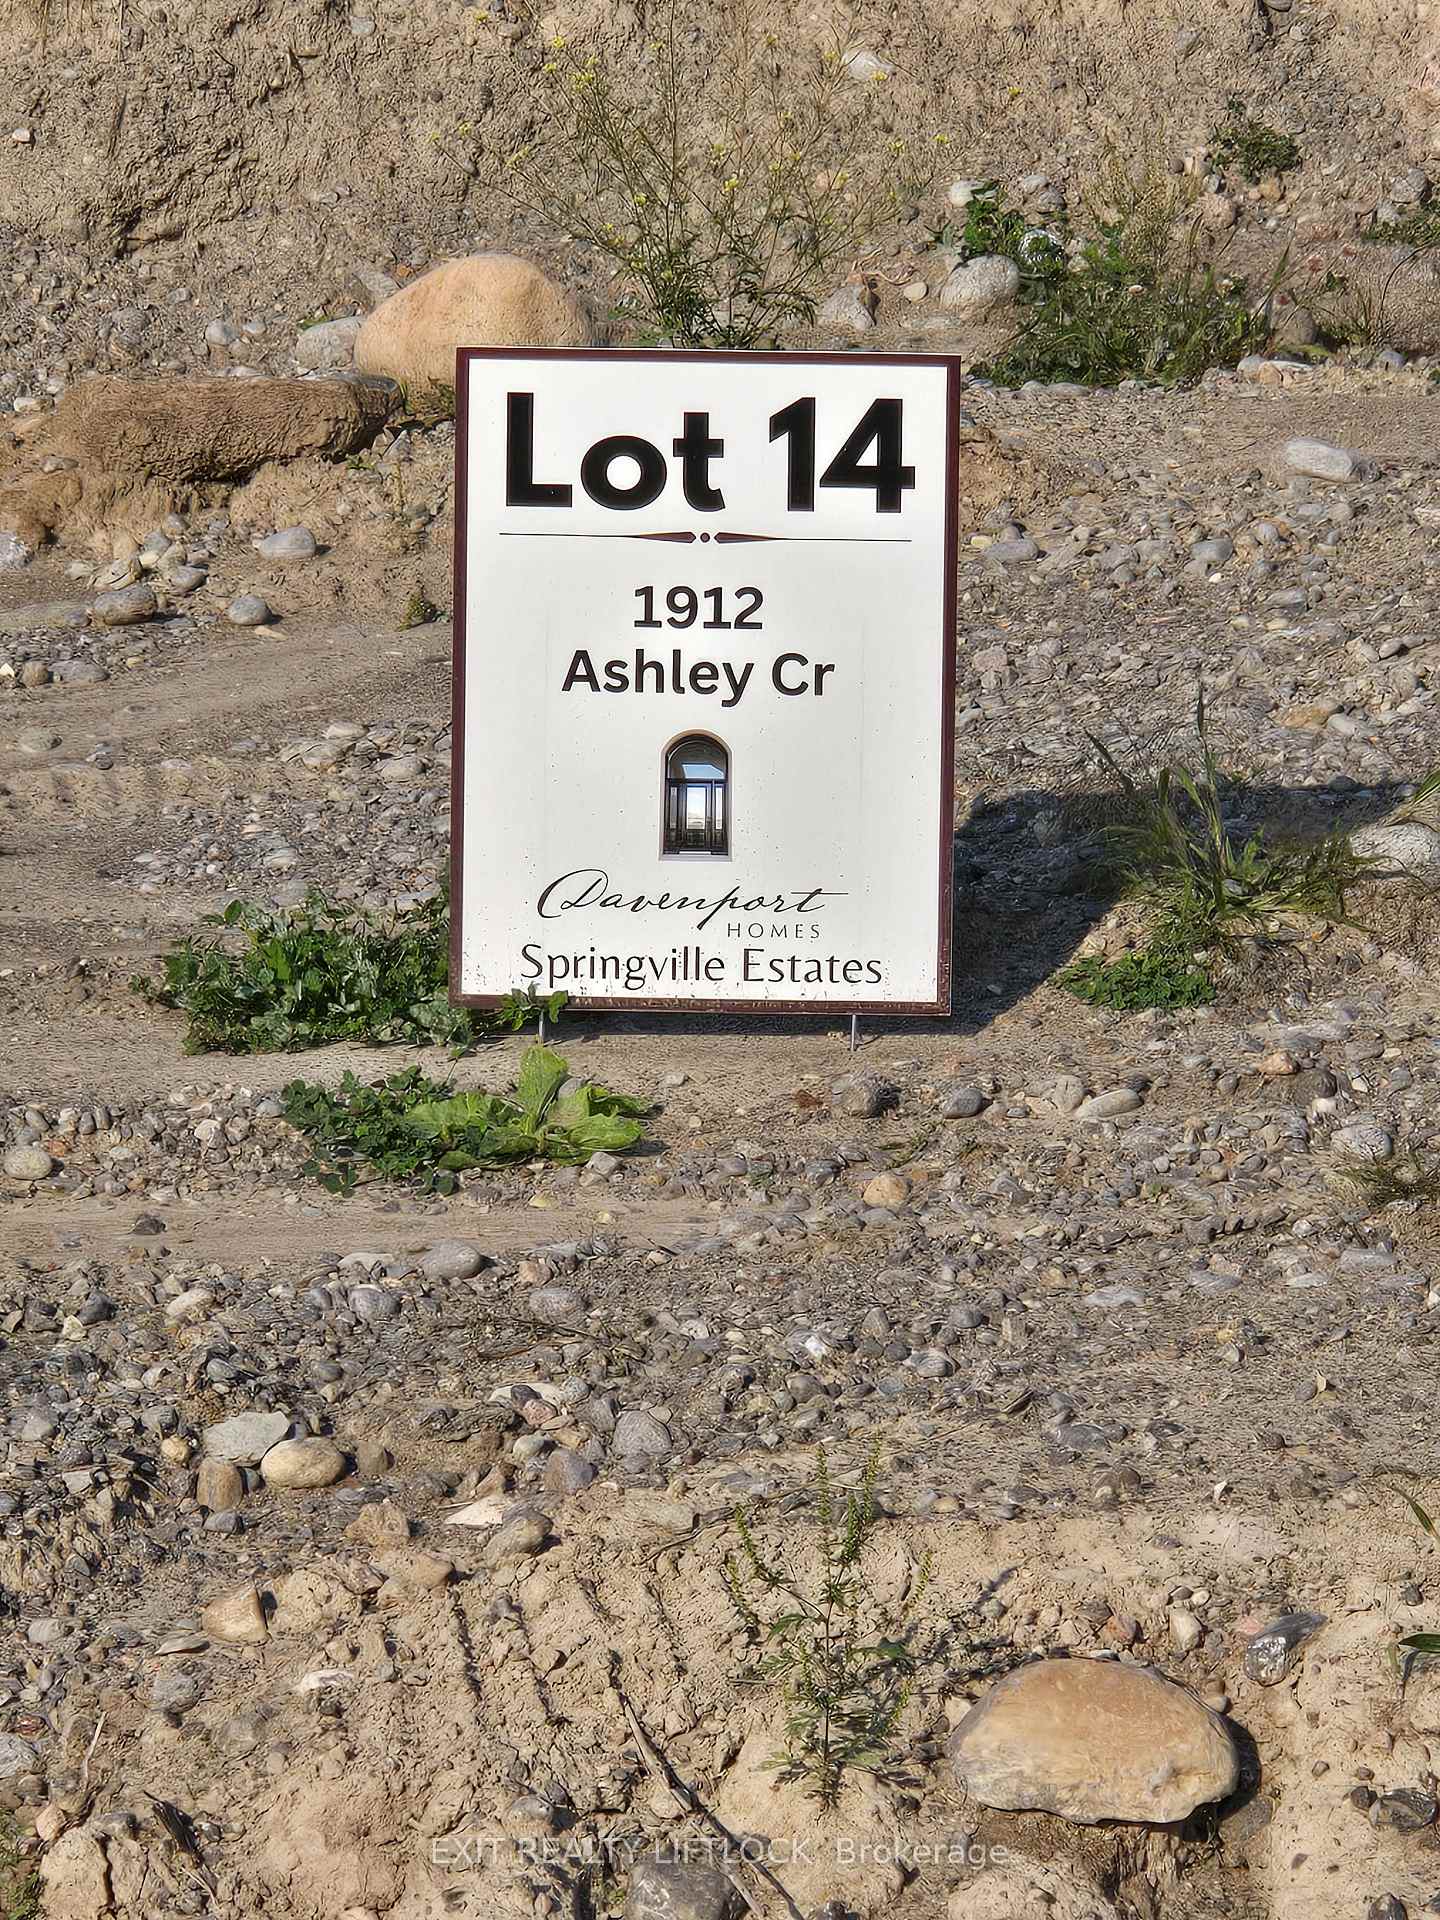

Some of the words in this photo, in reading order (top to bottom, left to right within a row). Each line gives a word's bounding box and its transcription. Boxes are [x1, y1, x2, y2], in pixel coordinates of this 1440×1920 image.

[505, 391, 727, 513] Lot
[768, 396, 917, 514] 14
[633, 585, 764, 630] 1912
[561, 648, 755, 709] Ashley
[771, 652, 836, 697] Cr
[536, 868, 849, 931] Davenport
[726, 922, 822, 939] HOMES
[520, 943, 726, 991] Springville
[743, 948, 883, 985] Estates
